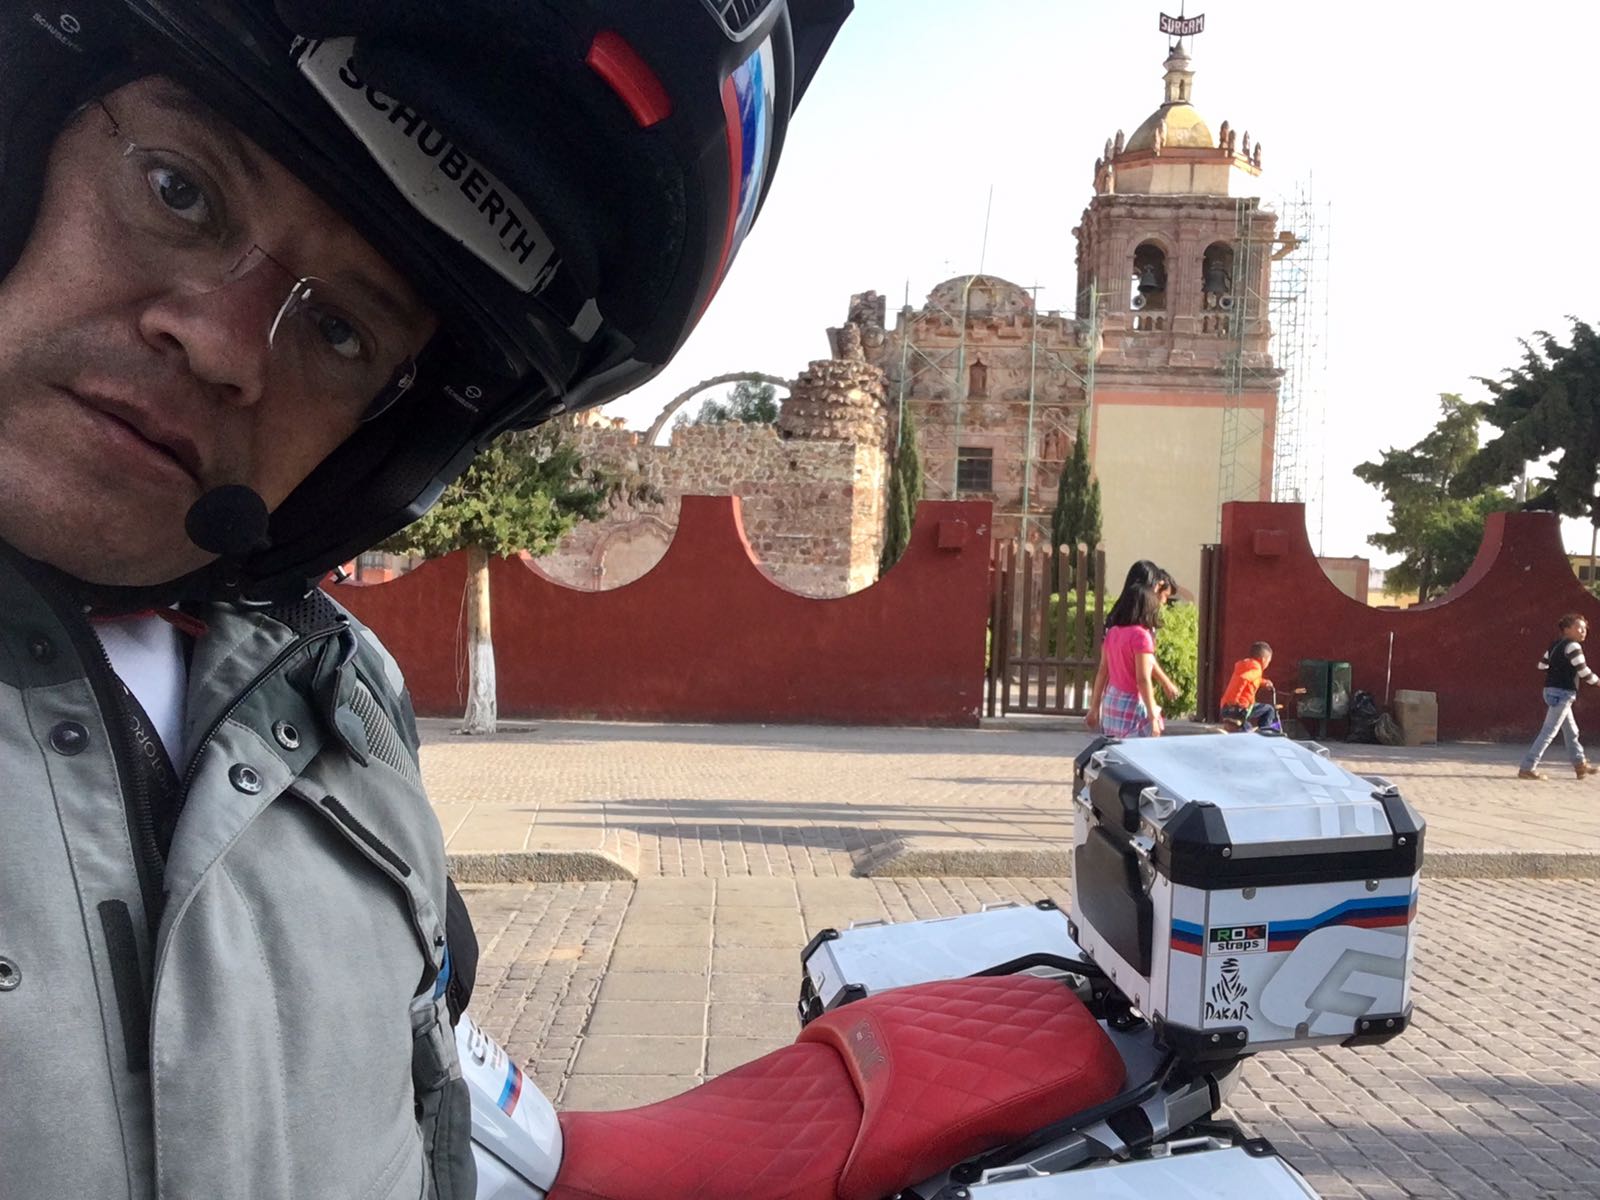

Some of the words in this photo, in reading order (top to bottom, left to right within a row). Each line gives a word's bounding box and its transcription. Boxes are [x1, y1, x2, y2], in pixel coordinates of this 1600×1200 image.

[1161, 15, 1204, 34] SURGAM
[1217, 927, 1260, 941] ROK
[1217, 940, 1260, 951] straps
[1205, 1001, 1254, 1021] DAKAR
